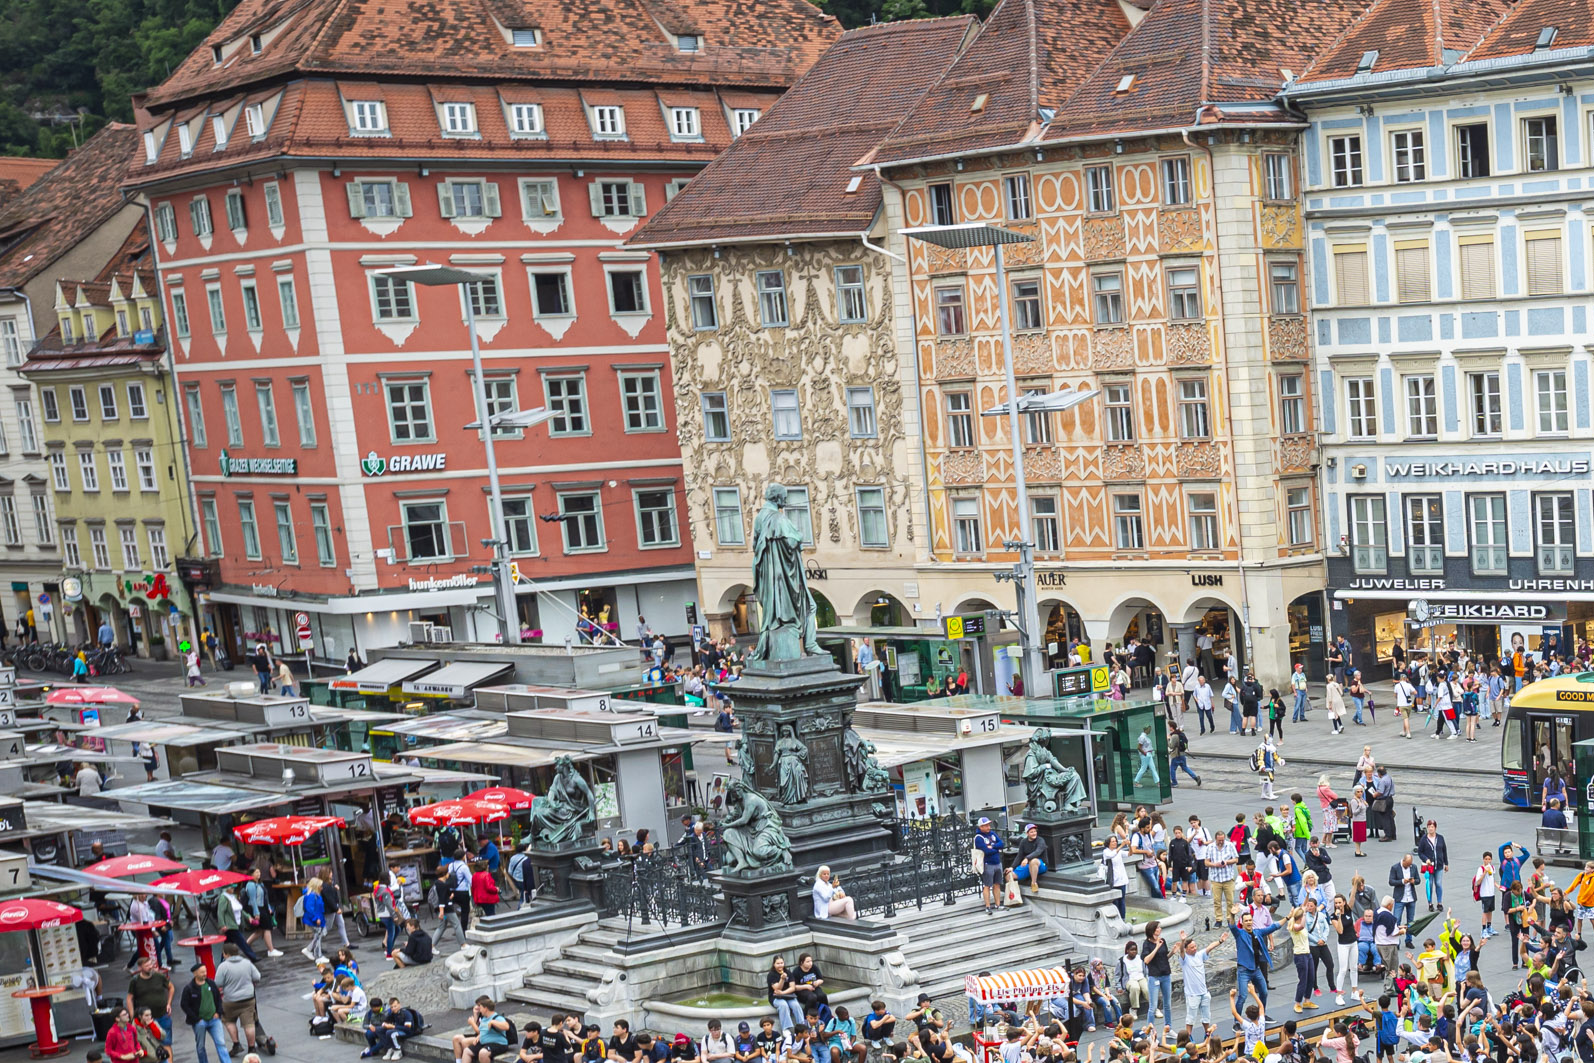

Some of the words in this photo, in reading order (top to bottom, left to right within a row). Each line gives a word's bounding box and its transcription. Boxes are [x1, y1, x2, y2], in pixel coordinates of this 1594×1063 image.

[389, 454, 446, 472] GRAWE
[805, 569, 828, 580] OVSKI
[1037, 573, 1066, 586] AUER
[1192, 575, 1222, 586] LUSH
[408, 574, 478, 591] hunkemöller
[1350, 579, 1445, 590] JUWELIER
[1559, 692, 1585, 702] GOOD
[289, 705, 305, 718] 13
[599, 700, 606, 711] 8
[1, 714, 9, 725] 3
[980, 719, 995, 732] 15
[637, 724, 652, 737] 14
[9, 742, 18, 754] 4
[348, 763, 367, 777] 12
[8, 868, 20, 884] 7
[997, 988, 1010, 996] Eis
[1047, 984, 1060, 992] Eis
